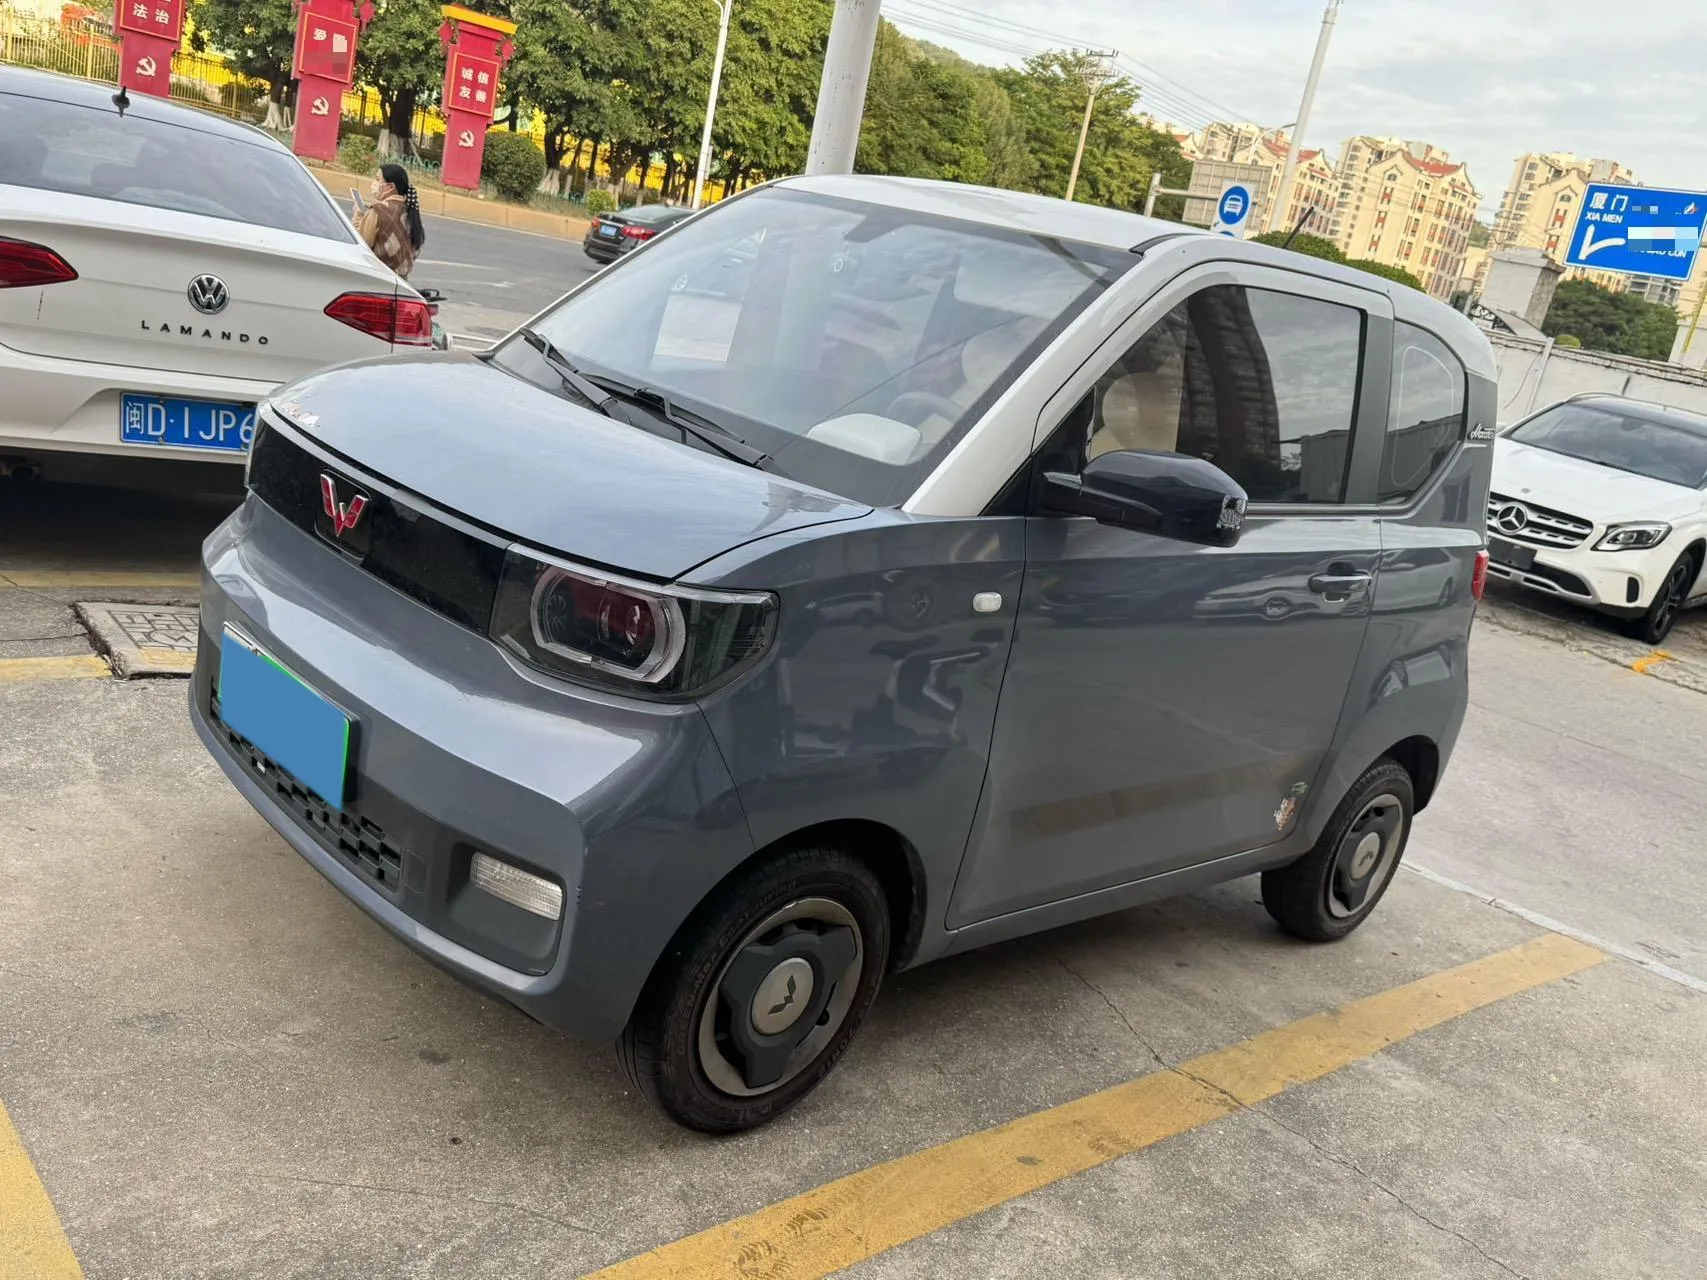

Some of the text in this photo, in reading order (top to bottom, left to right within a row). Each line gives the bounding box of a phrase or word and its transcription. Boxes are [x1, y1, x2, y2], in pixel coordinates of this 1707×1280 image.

[132, 3, 170, 24] 法治
[461, 67, 489, 85] 诚信
[459, 85, 487, 103] 友善
[1589, 192, 1629, 212] 厦门
[1585, 211, 1623, 223] XIA MEN
[141, 320, 269, 345] LAMANDO
